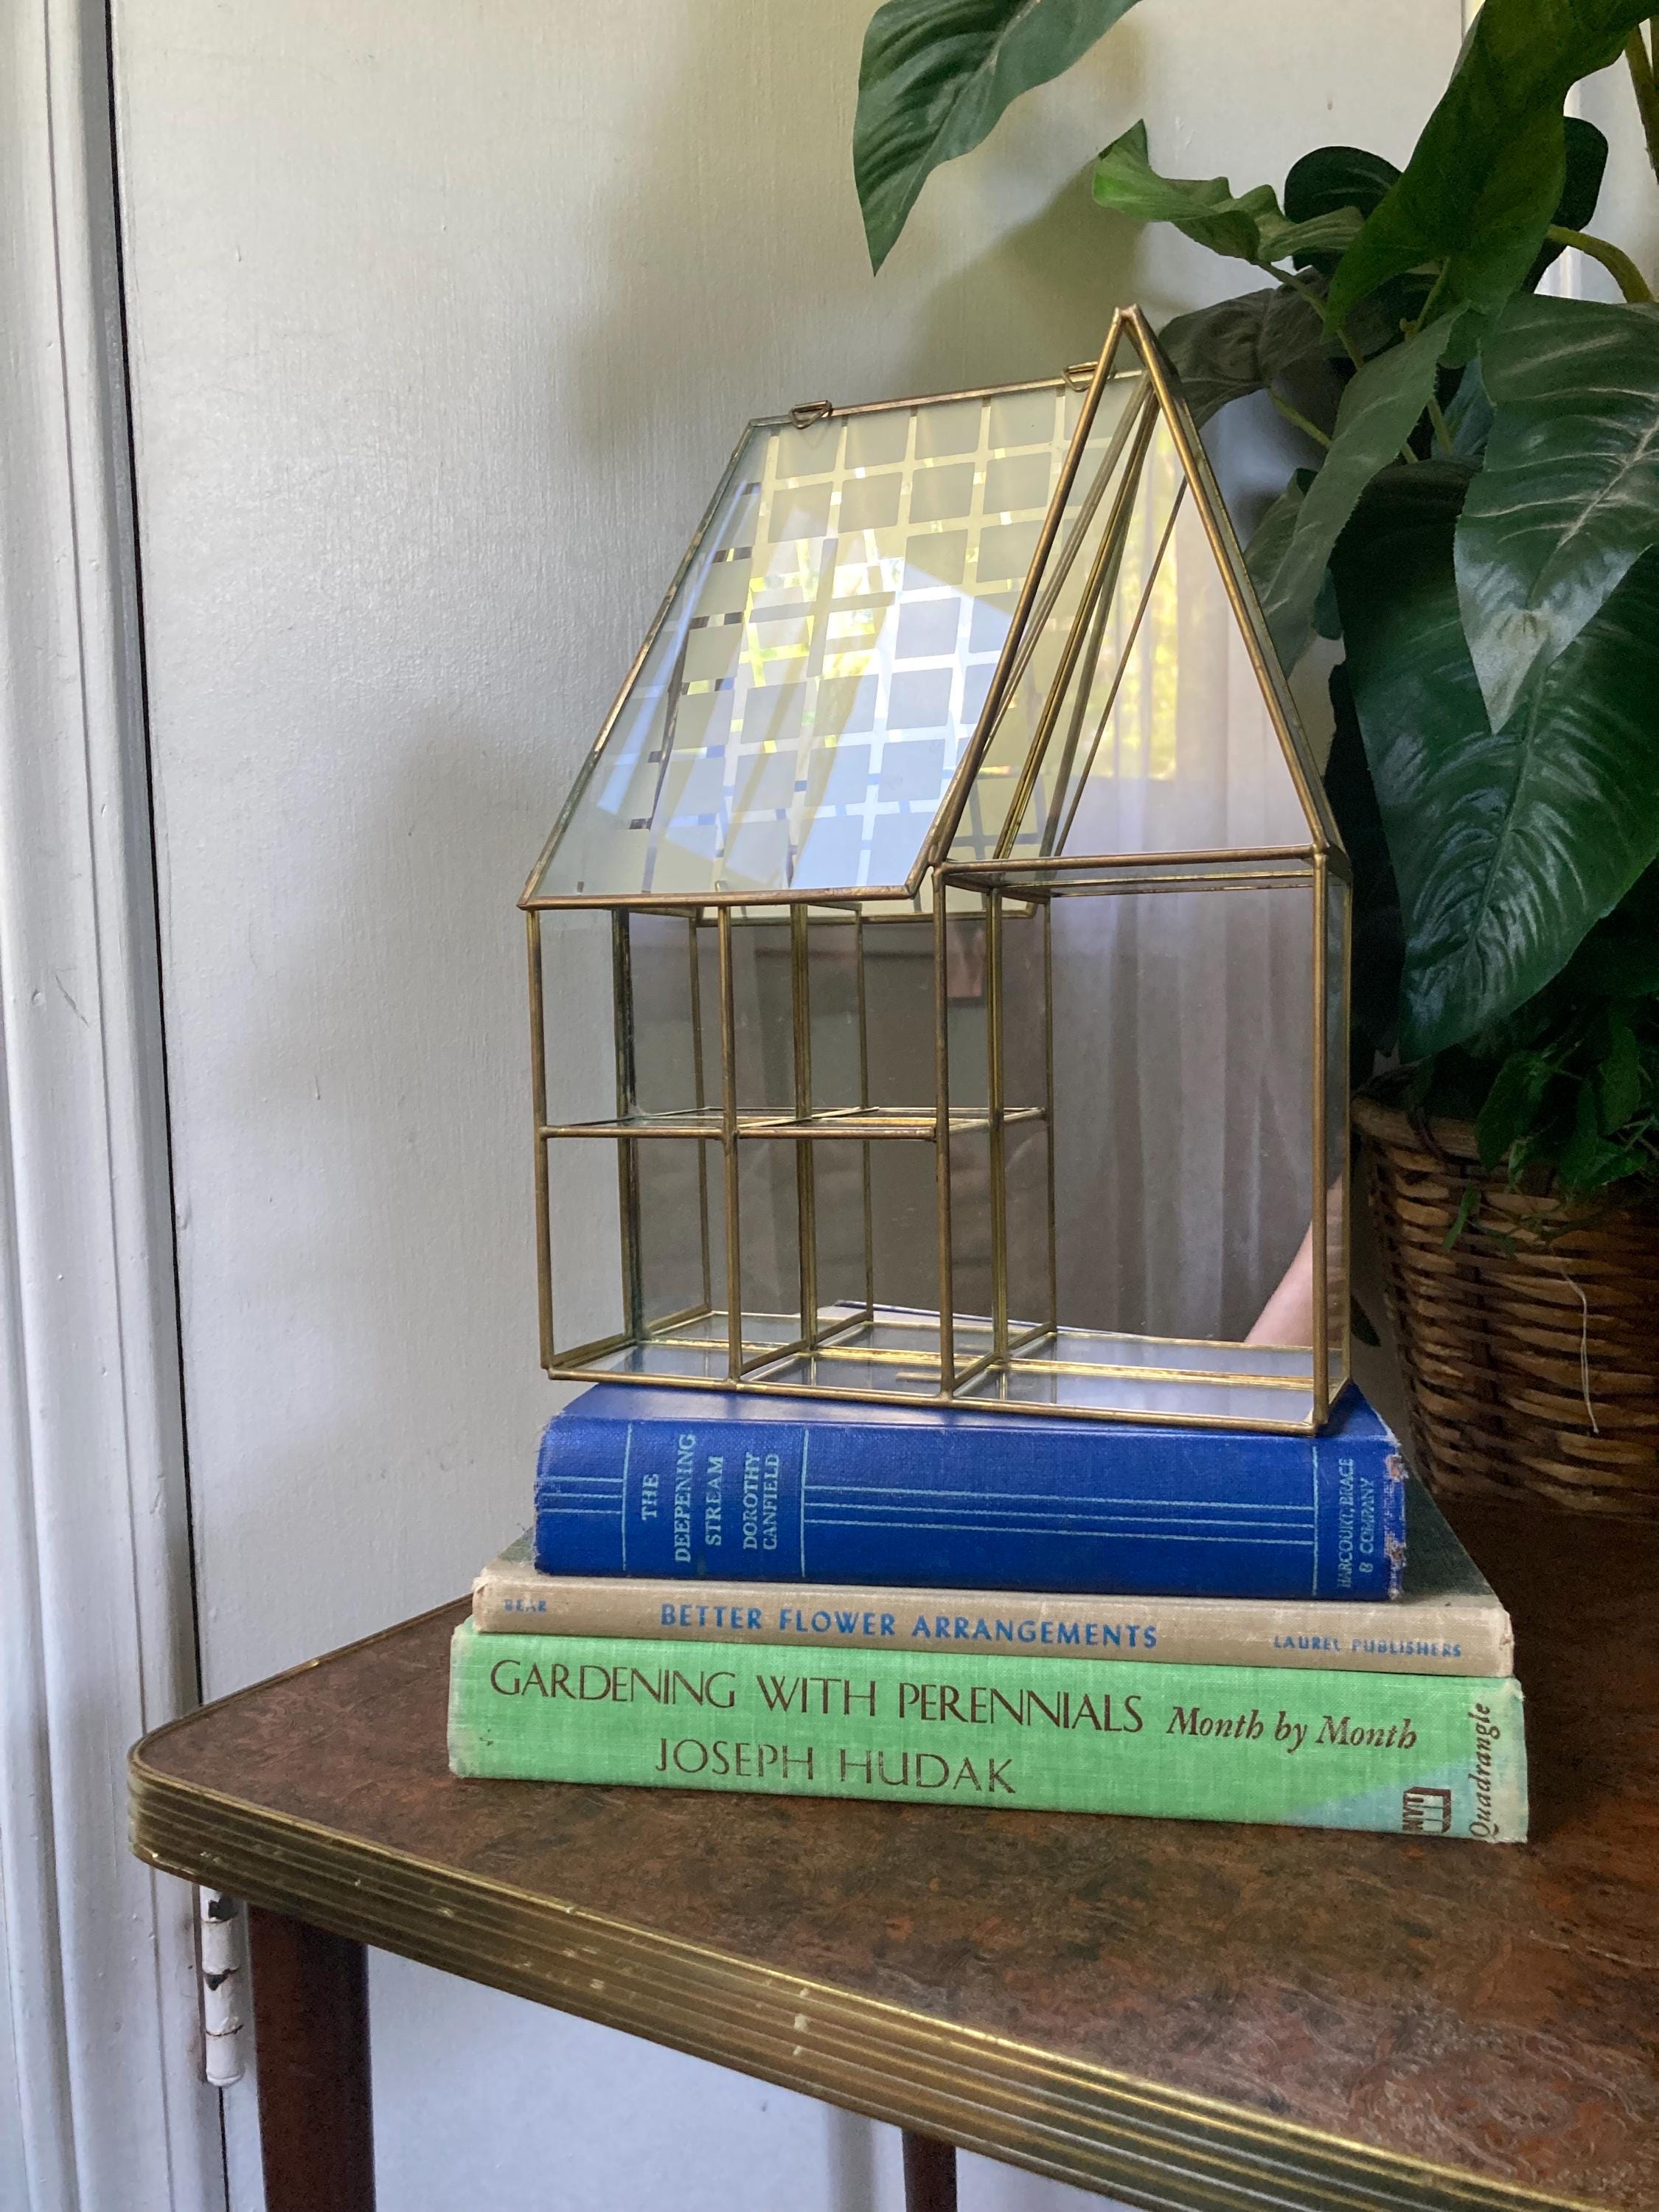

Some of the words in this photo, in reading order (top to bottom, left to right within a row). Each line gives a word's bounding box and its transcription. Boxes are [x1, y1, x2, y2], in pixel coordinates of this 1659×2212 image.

[641, 1474, 659, 1520] THE
[675, 1433, 697, 1563] DEEPENING
[705, 1455, 724, 1546] STREAM
[742, 1452, 761, 1550] DOROTHY
[762, 1453, 780, 1550] CANFIELD
[1338, 1458, 1354, 1506] BRACE
[1359, 1477, 1374, 1554] COMPANY
[661, 1603, 762, 1630] BETTER
[779, 1608, 895, 1636] FLOWER
[912, 1615, 1157, 1649] ARRANGEMENTS
[1273, 1635, 1340, 1652] LAUREL
[1352, 1638, 1461, 1657] PUBLISHERS
[490, 1659, 736, 1708] GARDENING
[757, 1674, 875, 1717] WITH
[899, 1682, 1144, 1733] PERENNIALS
[1166, 1706, 1264, 1740] Month
[1274, 1711, 1307, 1753] by
[1315, 1714, 1417, 1749] Month
[655, 1737, 813, 1780] JOSEPH
[840, 1748, 1016, 1794] HUDAK
[1468, 1703, 1501, 1838] Quadrangle
